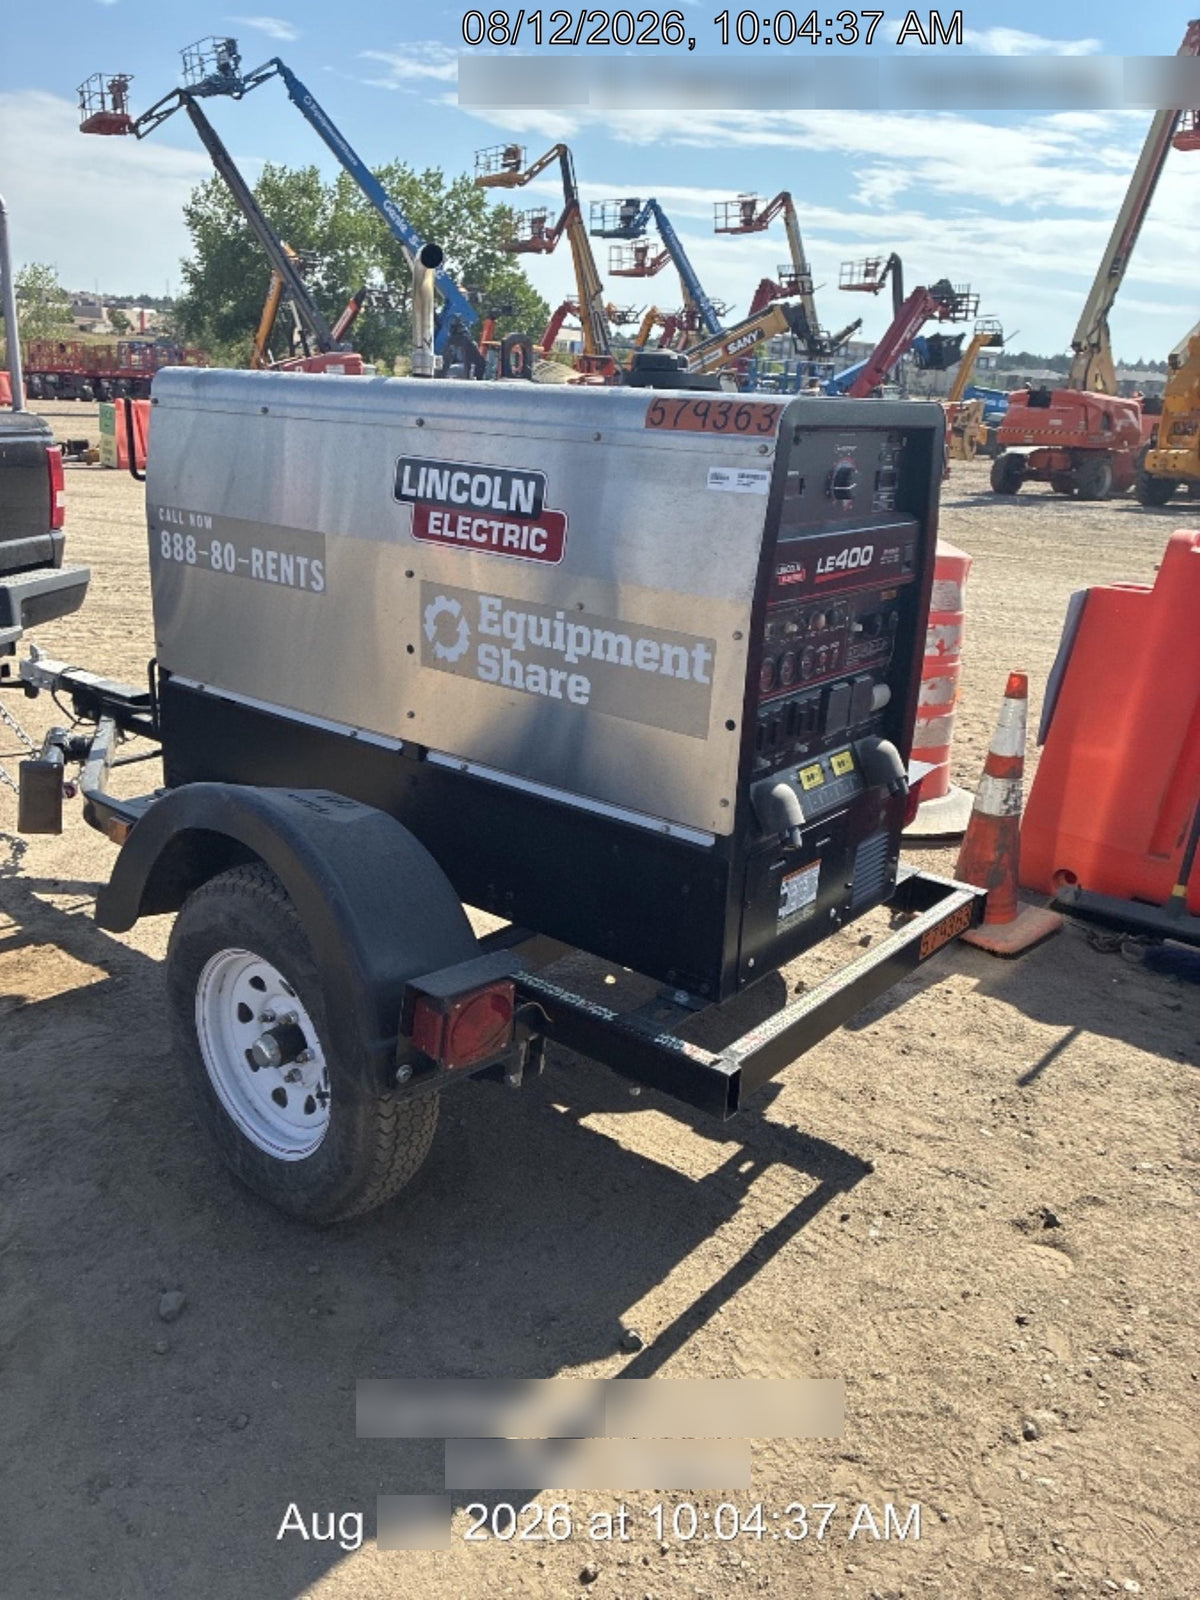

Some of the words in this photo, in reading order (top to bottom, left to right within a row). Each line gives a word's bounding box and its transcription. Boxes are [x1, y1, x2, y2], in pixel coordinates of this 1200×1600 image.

[383, 200, 408, 234] Genie
[727, 331, 759, 354] SANY
[649, 399, 778, 432] 579363
[401, 465, 536, 514] LINCOLN
[159, 507, 184, 525] CALL
[190, 514, 213, 529] NOW
[428, 511, 549, 553] ELECTRIC
[161, 530, 324, 592] 888-80-RENTS
[816, 545, 874, 574] LE400
[478, 595, 712, 685] Equipment
[477, 643, 591, 705] Share
